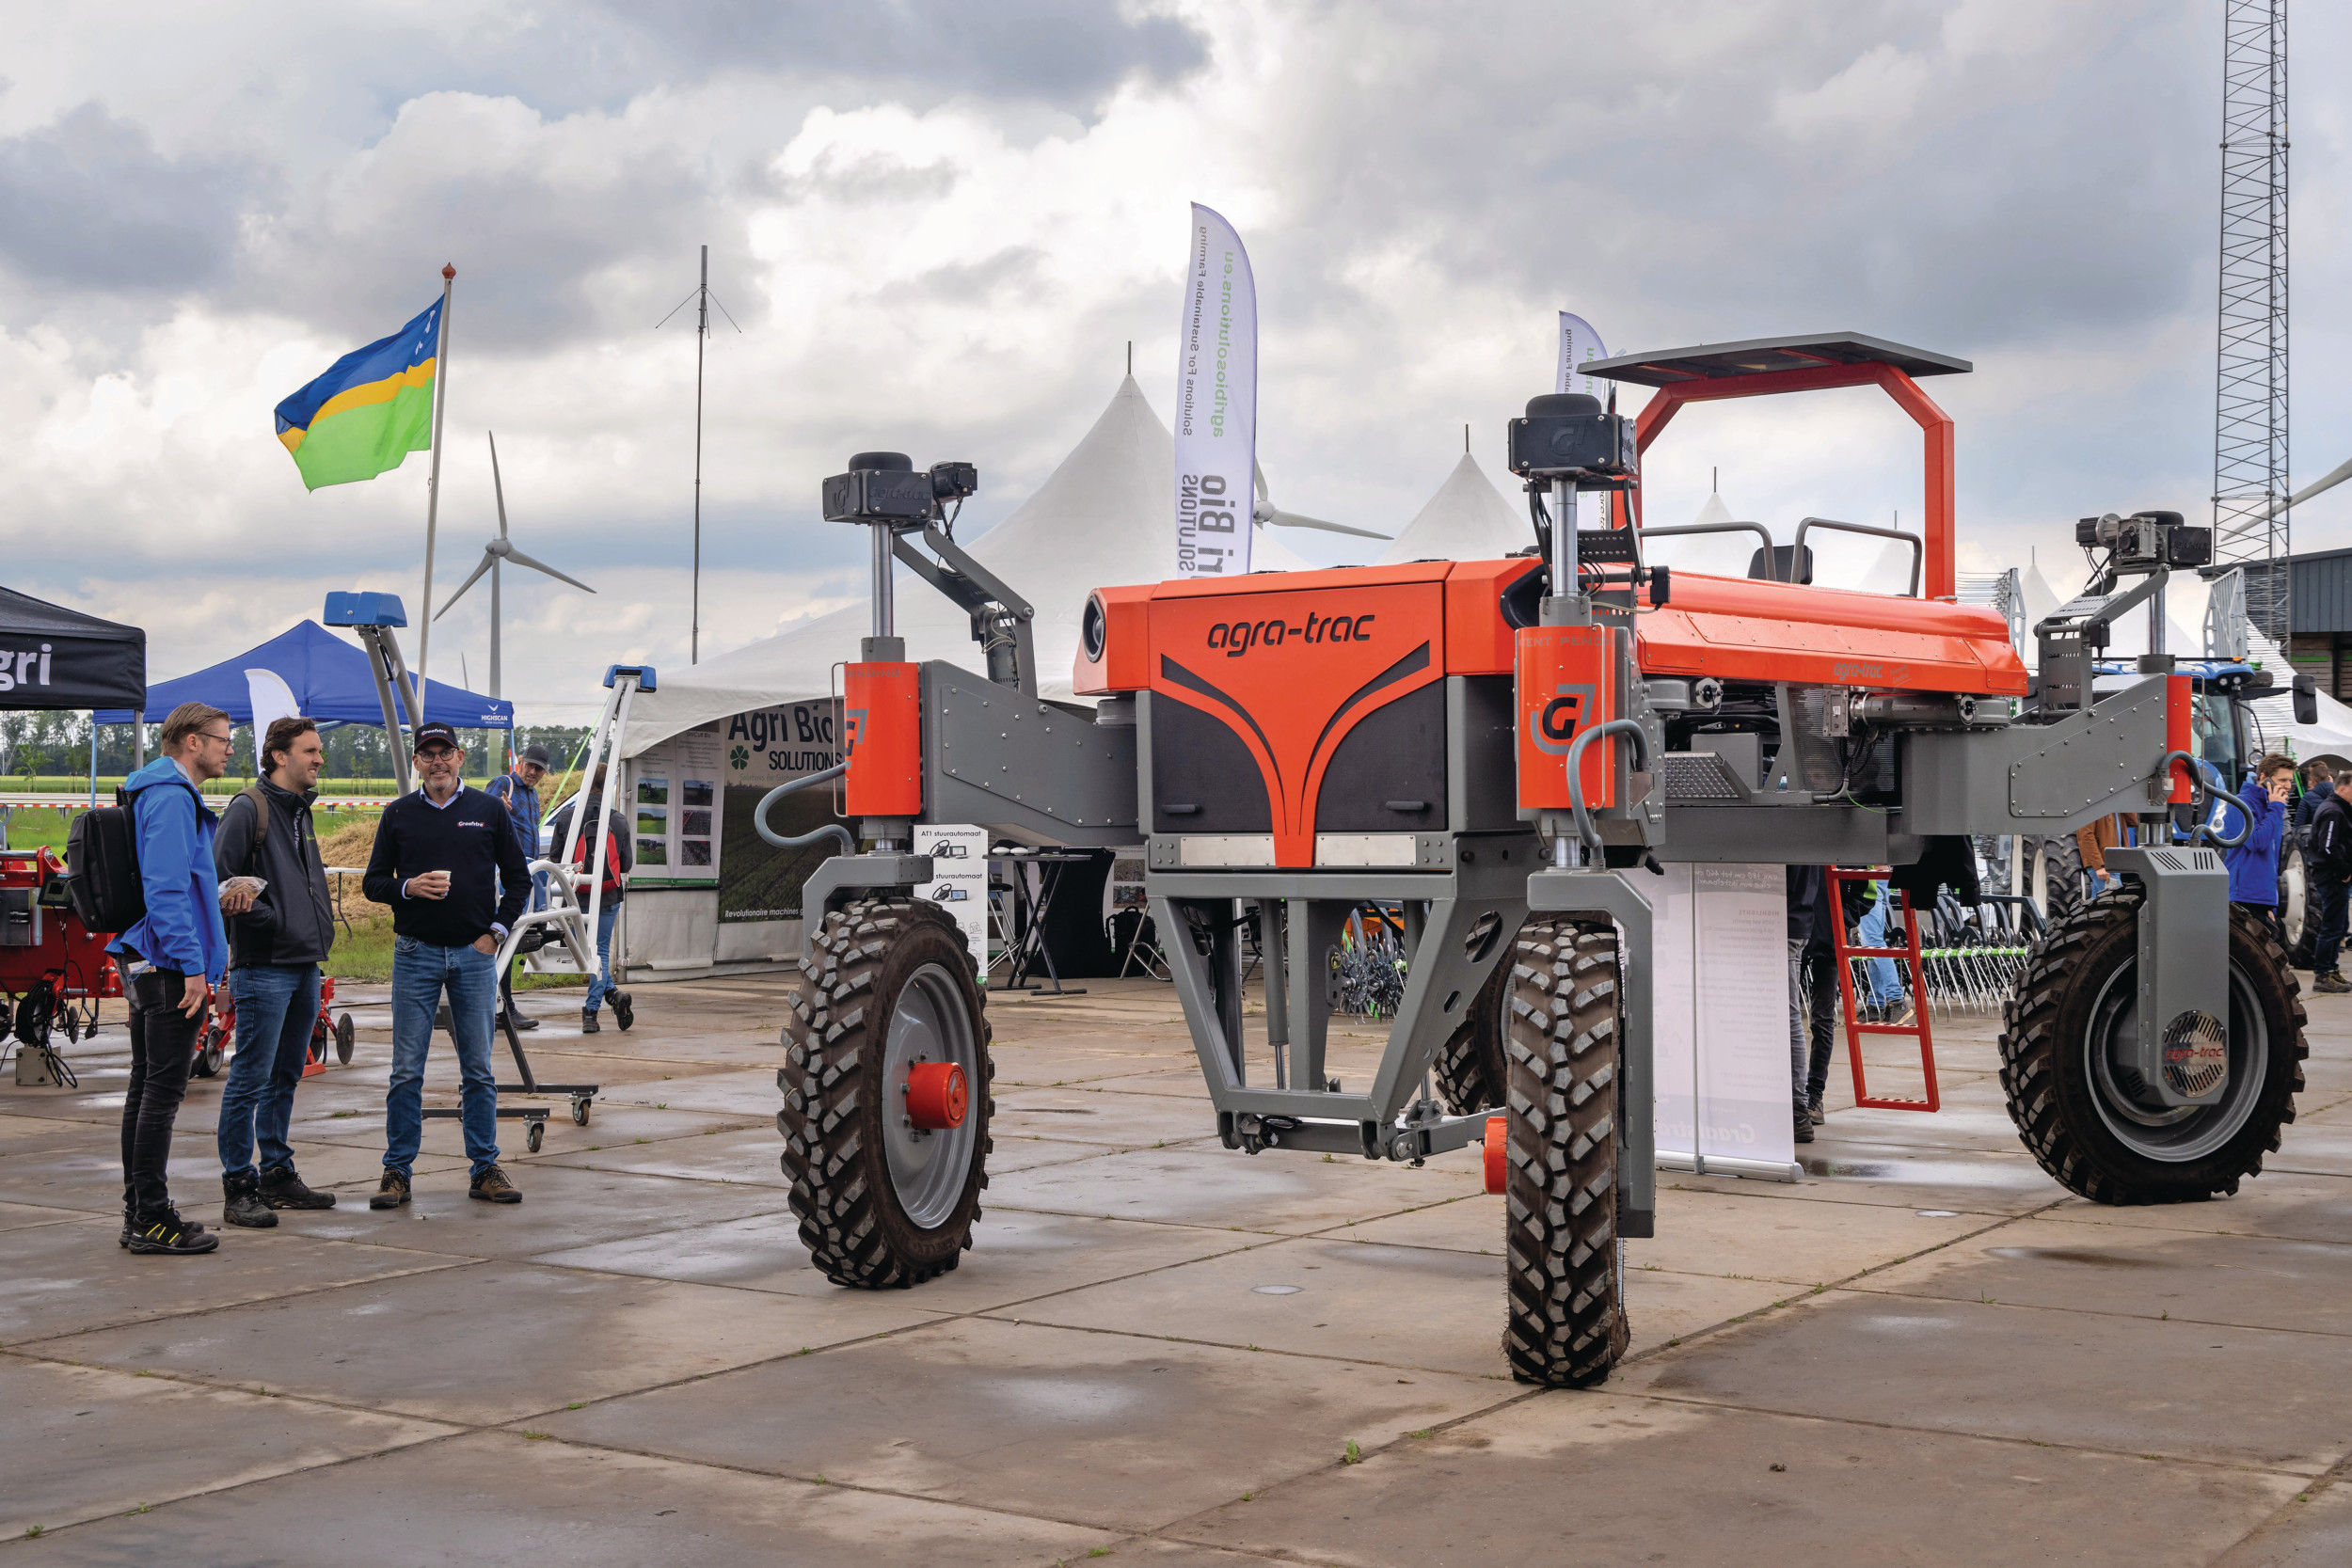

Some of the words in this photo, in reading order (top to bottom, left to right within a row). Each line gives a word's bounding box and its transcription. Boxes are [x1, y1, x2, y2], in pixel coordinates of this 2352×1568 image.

[1207, 611, 1375, 657] agra-trac
[1833, 661, 1883, 681] agra-trac
[728, 705, 788, 752] Agri
[794, 705, 838, 745] Bio
[769, 750, 843, 771] SOLUTIONS
[724, 908, 768, 918] Revolutionaire
[769, 908, 799, 916] machines
[2166, 1046, 2224, 1063] agra-trac
